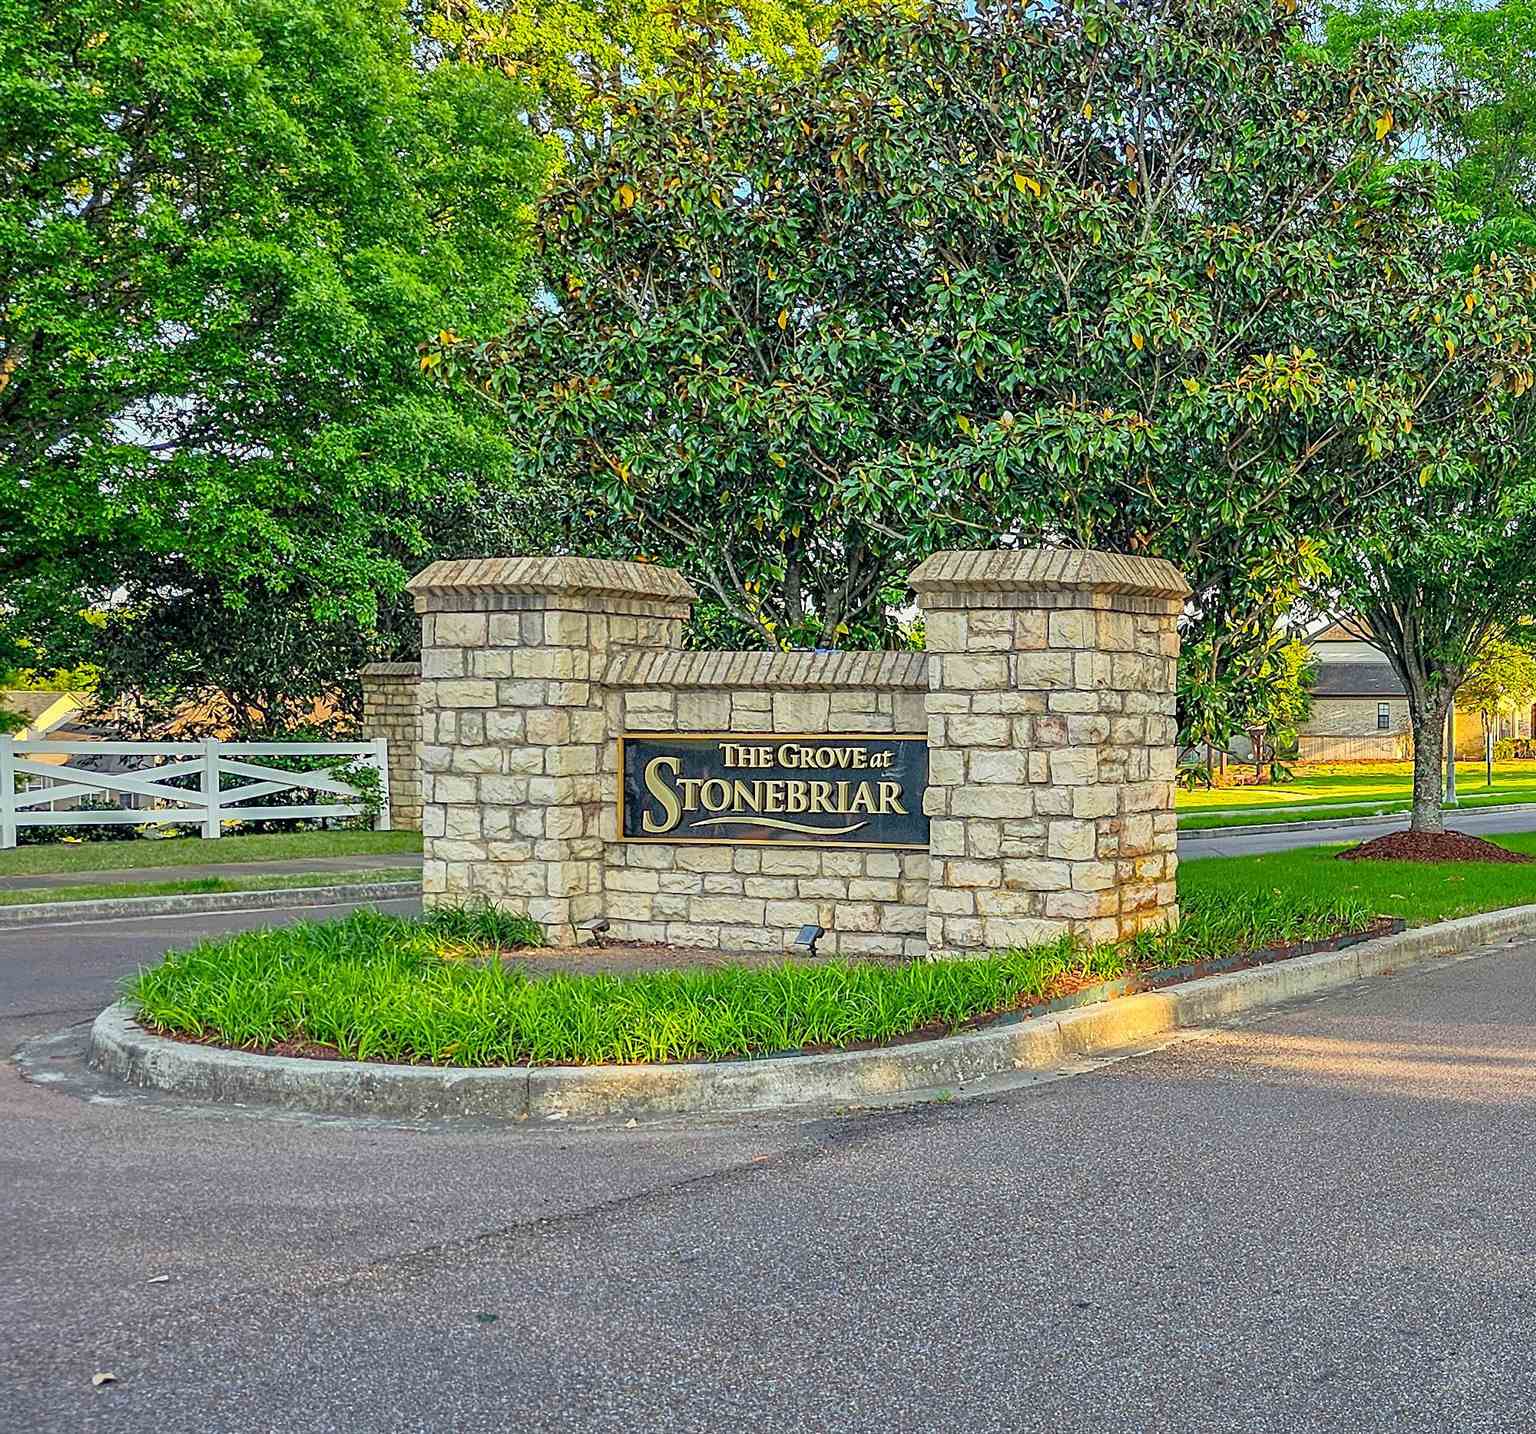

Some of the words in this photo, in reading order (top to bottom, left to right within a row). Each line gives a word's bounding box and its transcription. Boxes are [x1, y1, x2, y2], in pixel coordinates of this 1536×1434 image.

[718, 743, 773, 768] THE
[778, 744, 868, 769] GROVE
[870, 750, 894, 768] at
[642, 756, 909, 834] STONEBRIAR
